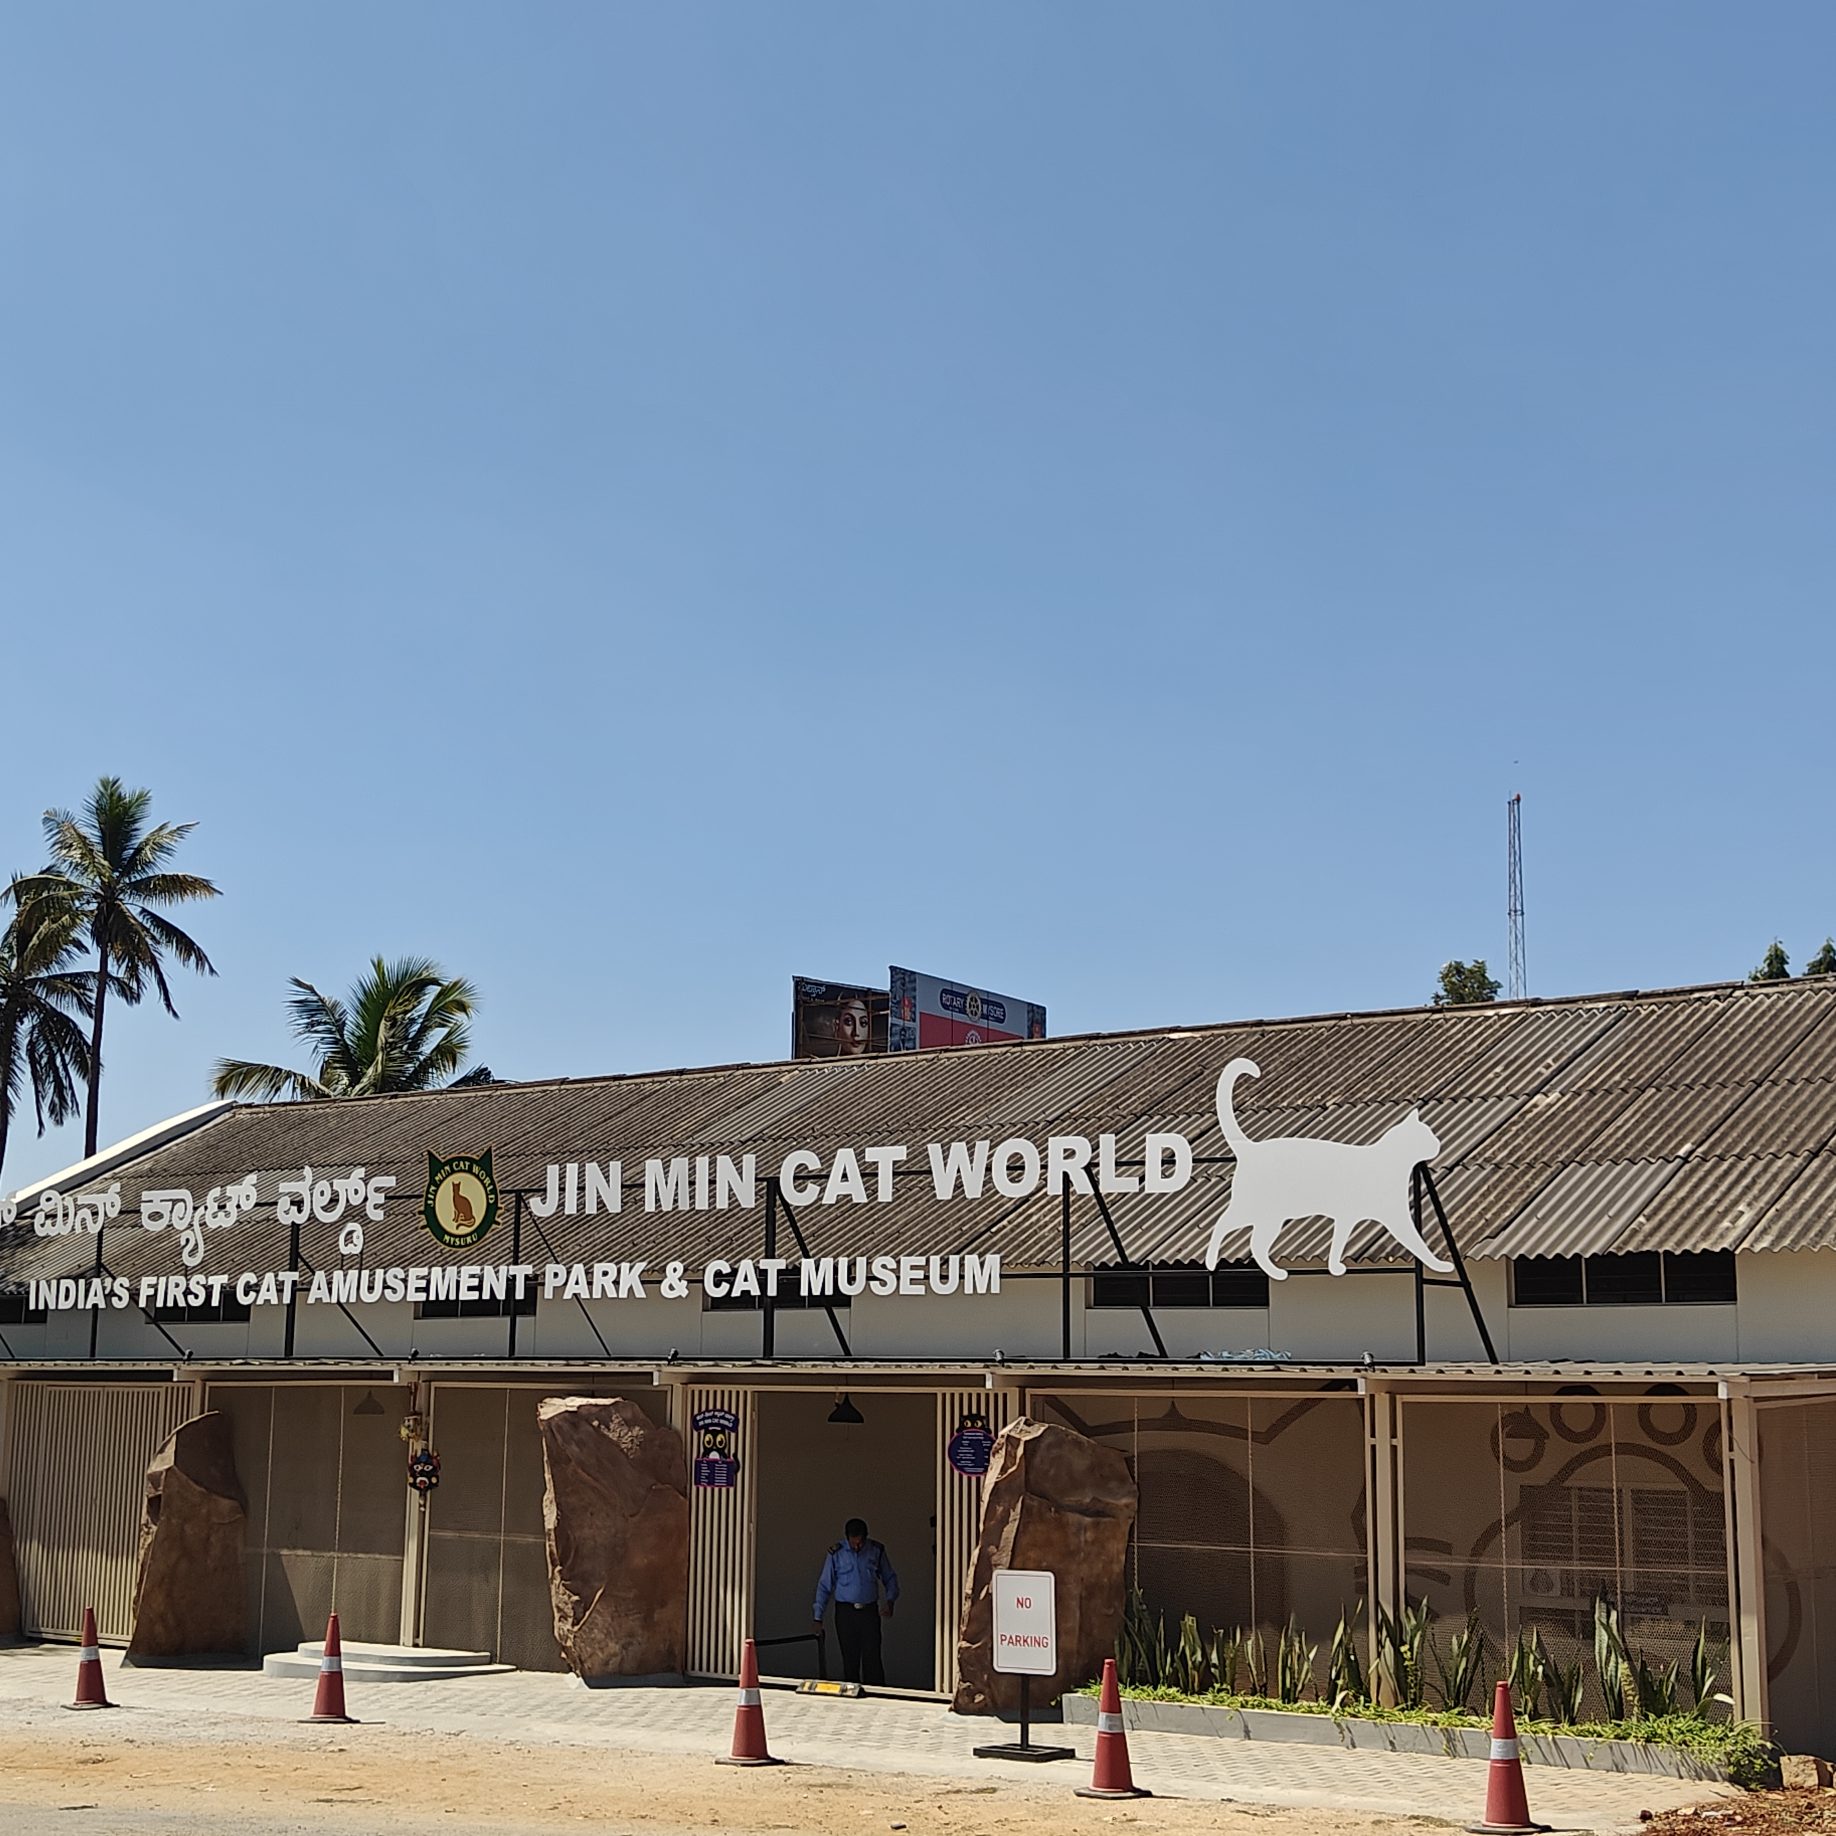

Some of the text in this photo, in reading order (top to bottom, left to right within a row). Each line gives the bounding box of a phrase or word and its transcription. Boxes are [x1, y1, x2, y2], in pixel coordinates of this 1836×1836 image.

[942, 992, 964, 1009] ROTARY
[427, 1161, 496, 1207] JIN MIN CAT WORLD
[529, 1133, 1193, 1217] JIN MIN CAT WORLD
[34, 1182, 121, 1237] ಮಿನ್
[140, 1174, 257, 1267] ಕ್ಯಾಟ್
[443, 1232, 478, 1246] MYSURU
[29, 1254, 1000, 1310] INDIA'S FIRST CAT AMUSEMENT PARK & CAT MUSEUM
[1016, 1597, 1032, 1609] NO
[1000, 1634, 1049, 1648] PARKING
